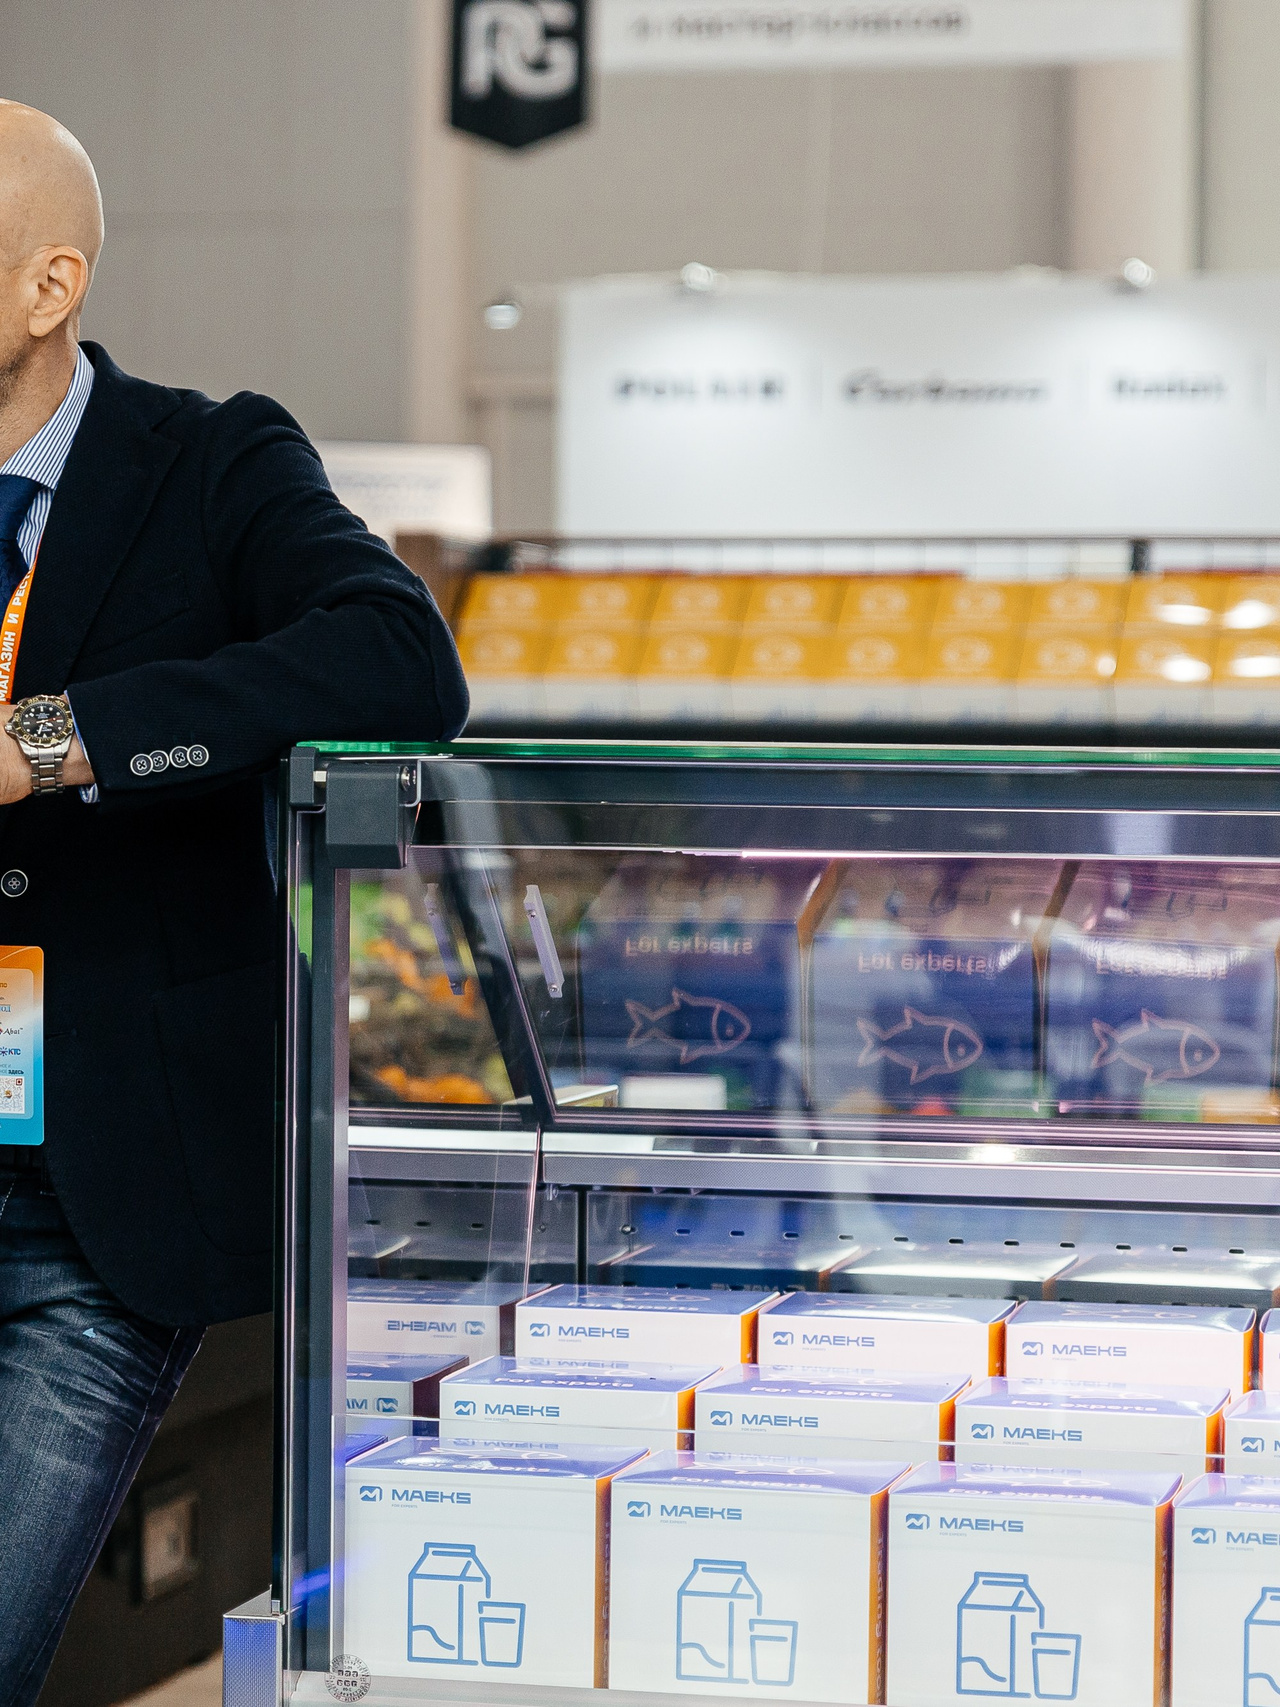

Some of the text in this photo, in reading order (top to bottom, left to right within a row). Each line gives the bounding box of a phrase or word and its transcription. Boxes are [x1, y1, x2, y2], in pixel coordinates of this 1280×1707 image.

[7, 613, 19, 624] И
[558, 1325, 630, 1338] MAEKS
[802, 1334, 875, 1347] MAEKS
[1052, 1344, 1127, 1357] MAEKS
[540, 1379, 634, 1388] experts
[798, 1388, 894, 1398] experts
[484, 1403, 560, 1417] MAEKS
[1057, 1401, 1158, 1412] experts
[741, 1413, 819, 1428] MAEKS
[1003, 1427, 1082, 1441] MAEKS
[722, 1479, 823, 1489] experts
[391, 1488, 471, 1504] MAEKS
[1000, 1490, 1104, 1500] experts
[660, 1504, 742, 1520] MAEKS
[939, 1516, 1024, 1532] MAEKS
[1226, 1531, 1280, 1546] MAE
